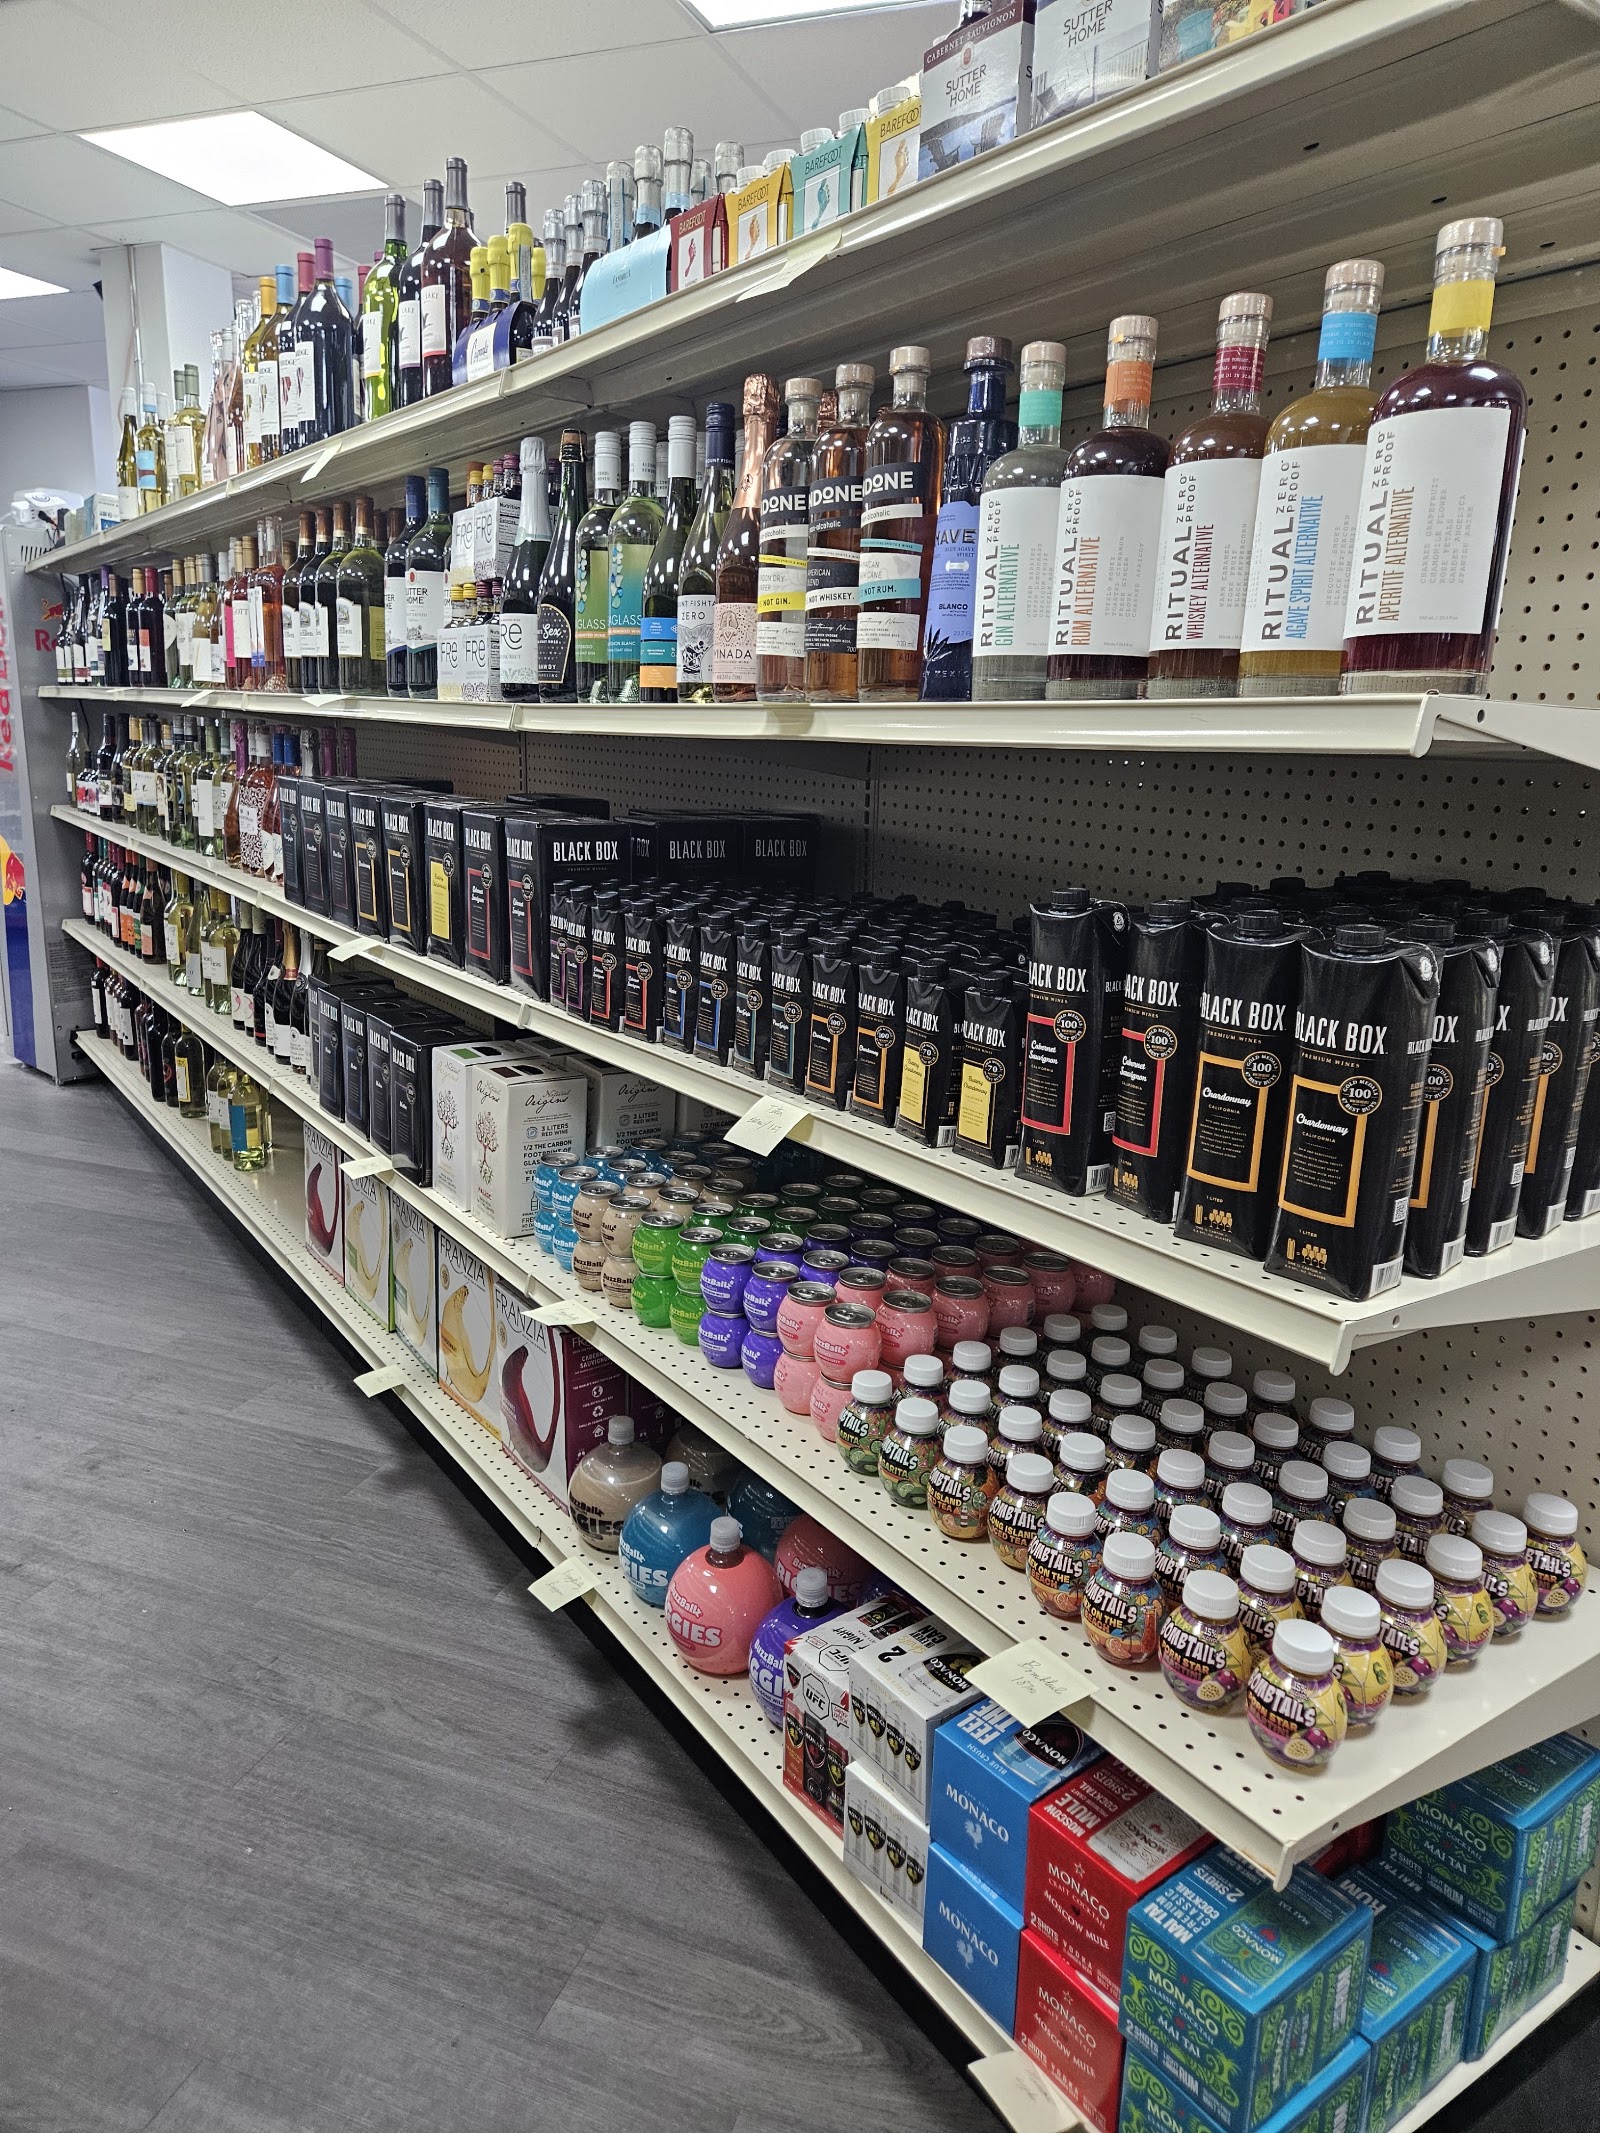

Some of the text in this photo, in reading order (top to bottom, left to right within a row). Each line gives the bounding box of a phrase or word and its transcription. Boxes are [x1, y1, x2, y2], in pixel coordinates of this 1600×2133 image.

[1063, 0, 1113, 35] SUTTER
[1068, 17, 1107, 48] HOME
[926, 9, 1016, 64] CABERNET SAUVIGNON
[945, 64, 987, 95] SUTTER
[949, 82, 982, 107] HOME
[880, 106, 921, 138] BAREFOOT
[805, 145, 843, 175] BAREFOOT
[737, 183, 770, 210] BAREFOOT
[678, 210, 707, 234] BAREFOOT
[1372, 432, 1385, 490] ZERO
[1382, 431, 1396, 487] PROOF
[862, 471, 913, 498] DONE
[1176, 473, 1187, 524] ZERO
[1186, 475, 1197, 523] PROOF
[1276, 460, 1290, 514] ZERO
[1286, 462, 1300, 513] PROOF
[761, 494, 806, 516] DONE
[1065, 488, 1075, 535] ZERO
[1072, 489, 1082, 535] PROOF
[986, 499, 995, 544] ZERO
[993, 500, 1002, 543] PROOF
[1285, 495, 1323, 639] AGAVE SPIRIT ALTERNATIVE
[1356, 491, 1388, 624] RITUAL
[1378, 486, 1415, 622] APERITIF ALTERNATIVE
[406, 588, 428, 596] UTTER
[878, 585, 897, 594] RUM.
[1055, 538, 1077, 646] RITUAL
[1071, 536, 1100, 646] RUM ALTERNATIVE
[1165, 526, 1192, 641] RITUAL
[1186, 524, 1214, 641] WHISKEY ALTERNATIVE
[1262, 517, 1294, 640] RITUAL
[980, 546, 999, 647] RITUAL
[995, 543, 1020, 646] GIN ALTERNATIVE
[578, 618, 606, 630] GLASS
[682, 612, 706, 620] ZERO
[428, 818, 454, 841] BLACK BOX
[466, 828, 492, 851] BLACK BOX
[506, 837, 533, 861] BLACK BOX
[553, 841, 620, 862] BLACK BOX.
[669, 840, 726, 860] BLACK BOX
[755, 838, 808, 858] BLACK BOX
[1057, 967, 1089, 992] BOX.
[1124, 974, 1181, 1008] ACK BOX.
[876, 998, 895, 1016] BOX
[922, 1013, 940, 1032] BOX
[1200, 992, 1287, 1032] BLACK BOX.
[964, 1020, 1006, 1048] LACK BOX
[1061, 1019, 1077, 1030] 100
[1207, 1030, 1262, 1044] PREMIUM WINES
[1295, 1011, 1389, 1055] BLACK BOX.
[1150, 1035, 1168, 1046] 100
[988, 1064, 998, 1072] 70
[1252, 1062, 1272, 1073] 100
[1301, 1052, 1360, 1069] PREMIUM WINES
[526, 1094, 568, 1114] Origins
[1202, 1087, 1252, 1108] Chardonnay
[1348, 1087, 1372, 1100] 100
[1208, 1104, 1240, 1115] CALIFORNIA
[1296, 1113, 1350, 1136] Chardonnay
[546, 1123, 568, 1131] LITERS
[638, 1127, 662, 1136] CARBON
[1302, 1131, 1336, 1144] CALIFORNIA
[548, 1140, 572, 1148] CARBON
[392, 1192, 426, 1238] FRANZIA
[440, 1232, 486, 1288] FRANZIA
[494, 1287, 547, 1349] FRANZIA
[582, 1352, 604, 1362] CABERN
[934, 1492, 962, 1507] ISLAND
[1028, 1536, 1082, 1578] BOMBTAILS
[1030, 1568, 1058, 1589] BEACH
[1049, 1566, 1070, 1583] THE
[878, 1646, 907, 1662] 2
[1162, 1616, 1226, 1668] BOMBTAILS
[930, 1658, 972, 1692] MONACO
[1182, 1656, 1210, 1675] STAR
[806, 1688, 826, 1710] UFC
[956, 1714, 1001, 1746] FEEL
[966, 1743, 992, 1766] CRUSH
[1022, 1728, 1070, 1765] MONACO
[946, 1783, 1010, 1844] MONACO
[1044, 1804, 1086, 1838] MOSCOW
[1056, 1792, 1105, 1830] MULE
[1416, 1800, 1488, 1853] MONACO
[1124, 1820, 1169, 1855] MONACO
[1423, 1838, 1469, 1876] MAI TAI
[1048, 1862, 1110, 1921] MONACO
[1194, 1866, 1226, 1894] SHOTS
[1155, 1895, 1200, 1933] PREMIUM
[1177, 1882, 1220, 1919] COCKTAIL
[938, 1901, 999, 1968] MONACO
[1038, 1916, 1060, 1943] SHOTS
[1044, 1889, 1110, 1951] MOSCOW MULE
[1233, 1923, 1286, 1964] MONACO
[1149, 1967, 1218, 2036] MONACO
[1038, 1986, 1097, 2050] MONACO
[1157, 2014, 1181, 2039] MAI
[1034, 2013, 1072, 2061] MOSCOW
[1134, 2026, 1160, 2054] SHOTS
